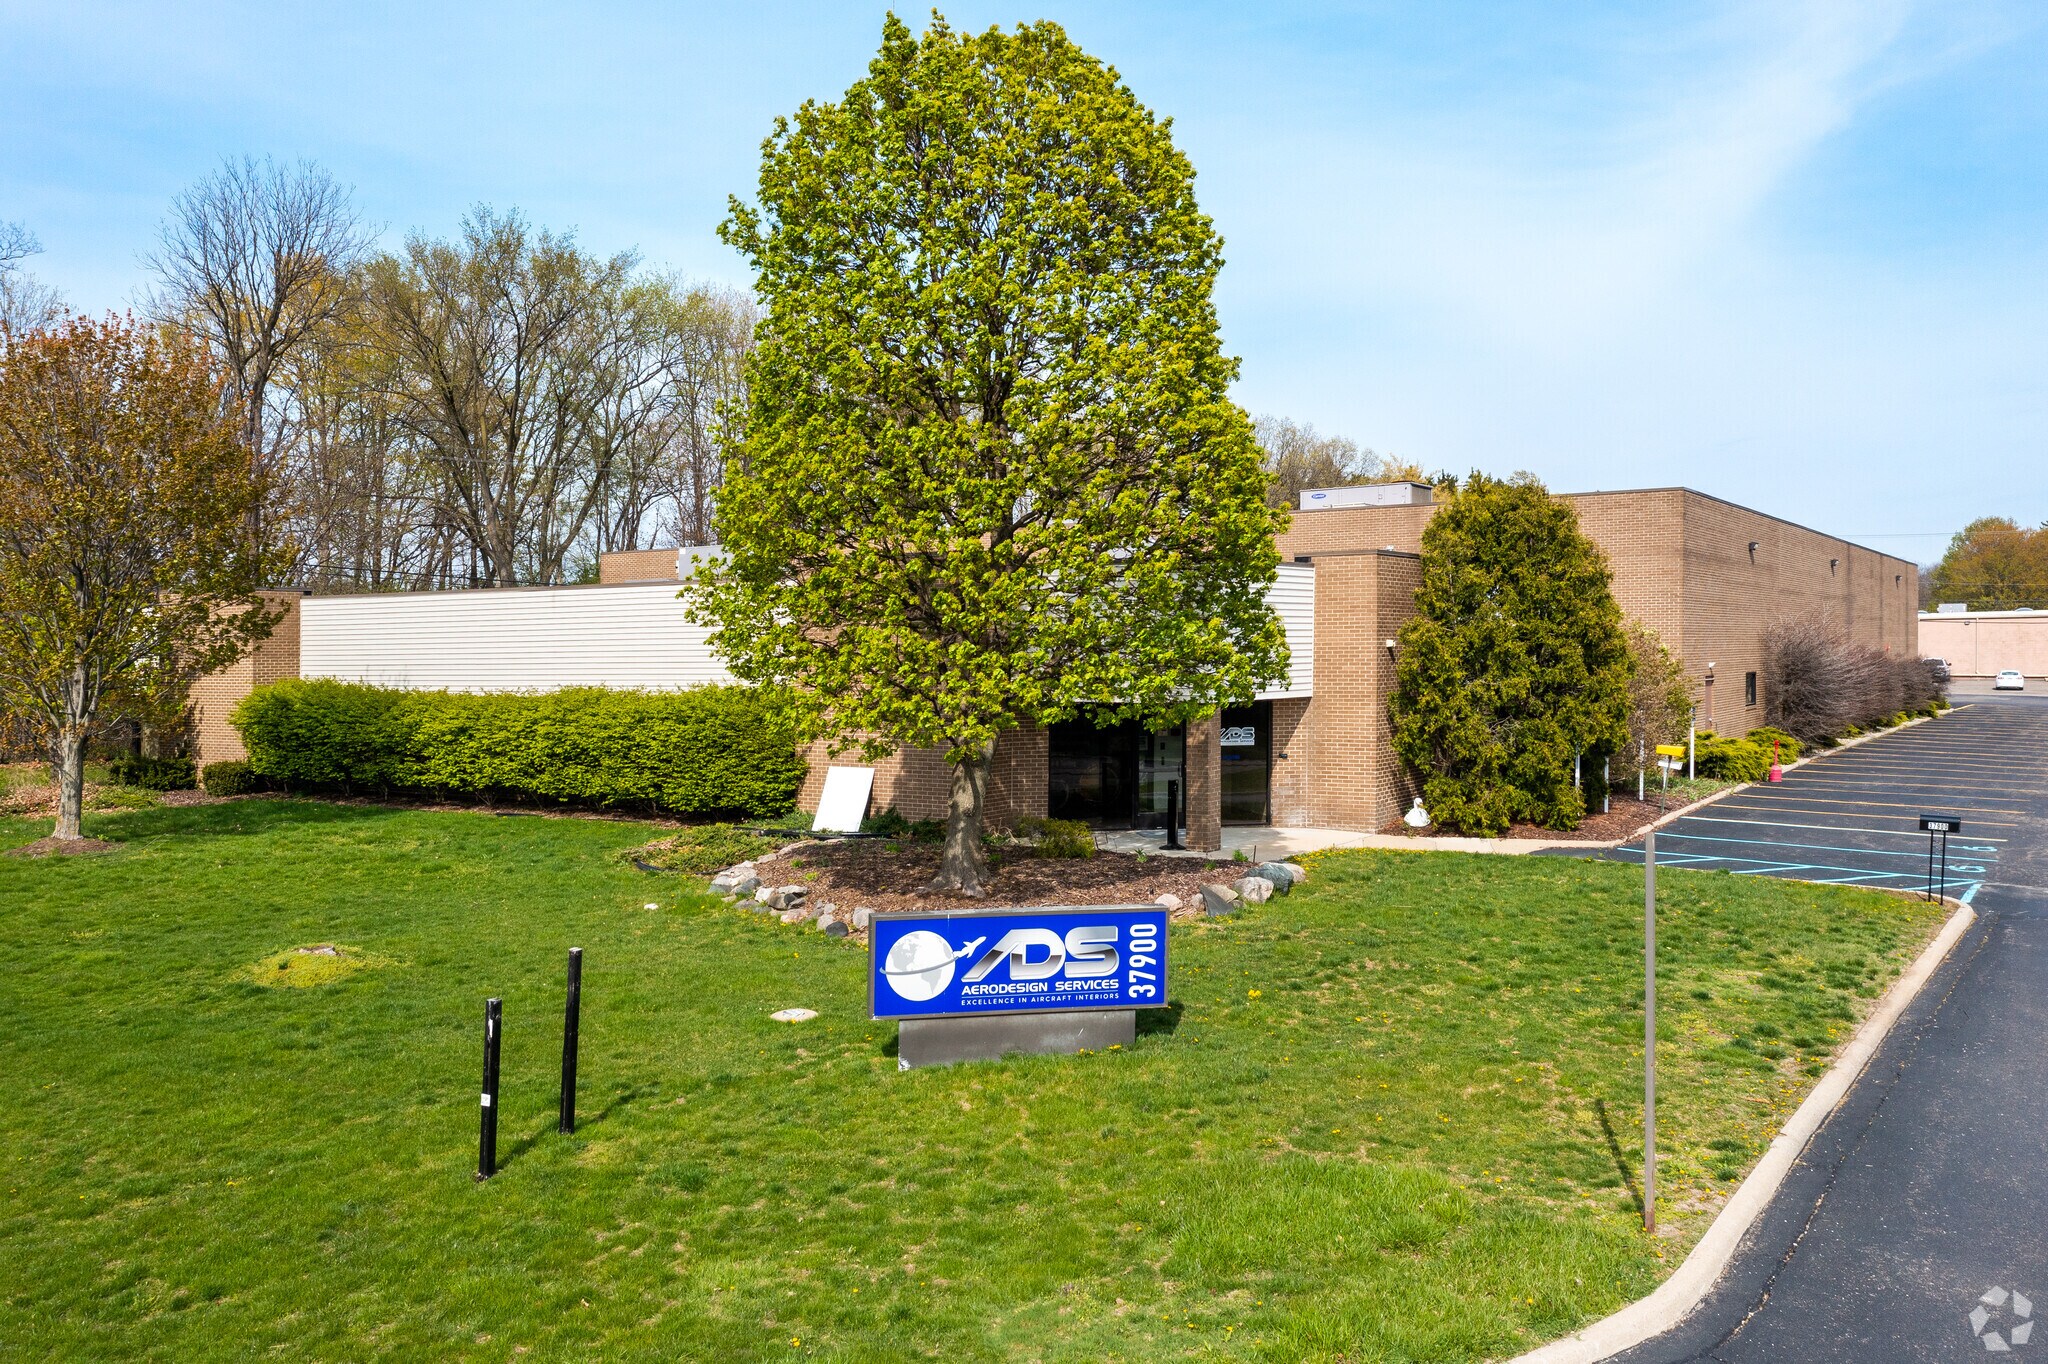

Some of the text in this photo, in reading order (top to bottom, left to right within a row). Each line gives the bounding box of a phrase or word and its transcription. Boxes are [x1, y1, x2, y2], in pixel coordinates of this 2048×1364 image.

[961, 925, 1120, 983] ADS
[1128, 923, 1158, 998] 37900
[961, 979, 1119, 995] AERODESIGN SERVICES
[961, 997, 1015, 1006] EXCELLENCE
[1031, 995, 1072, 1003] AIRCRAFT
